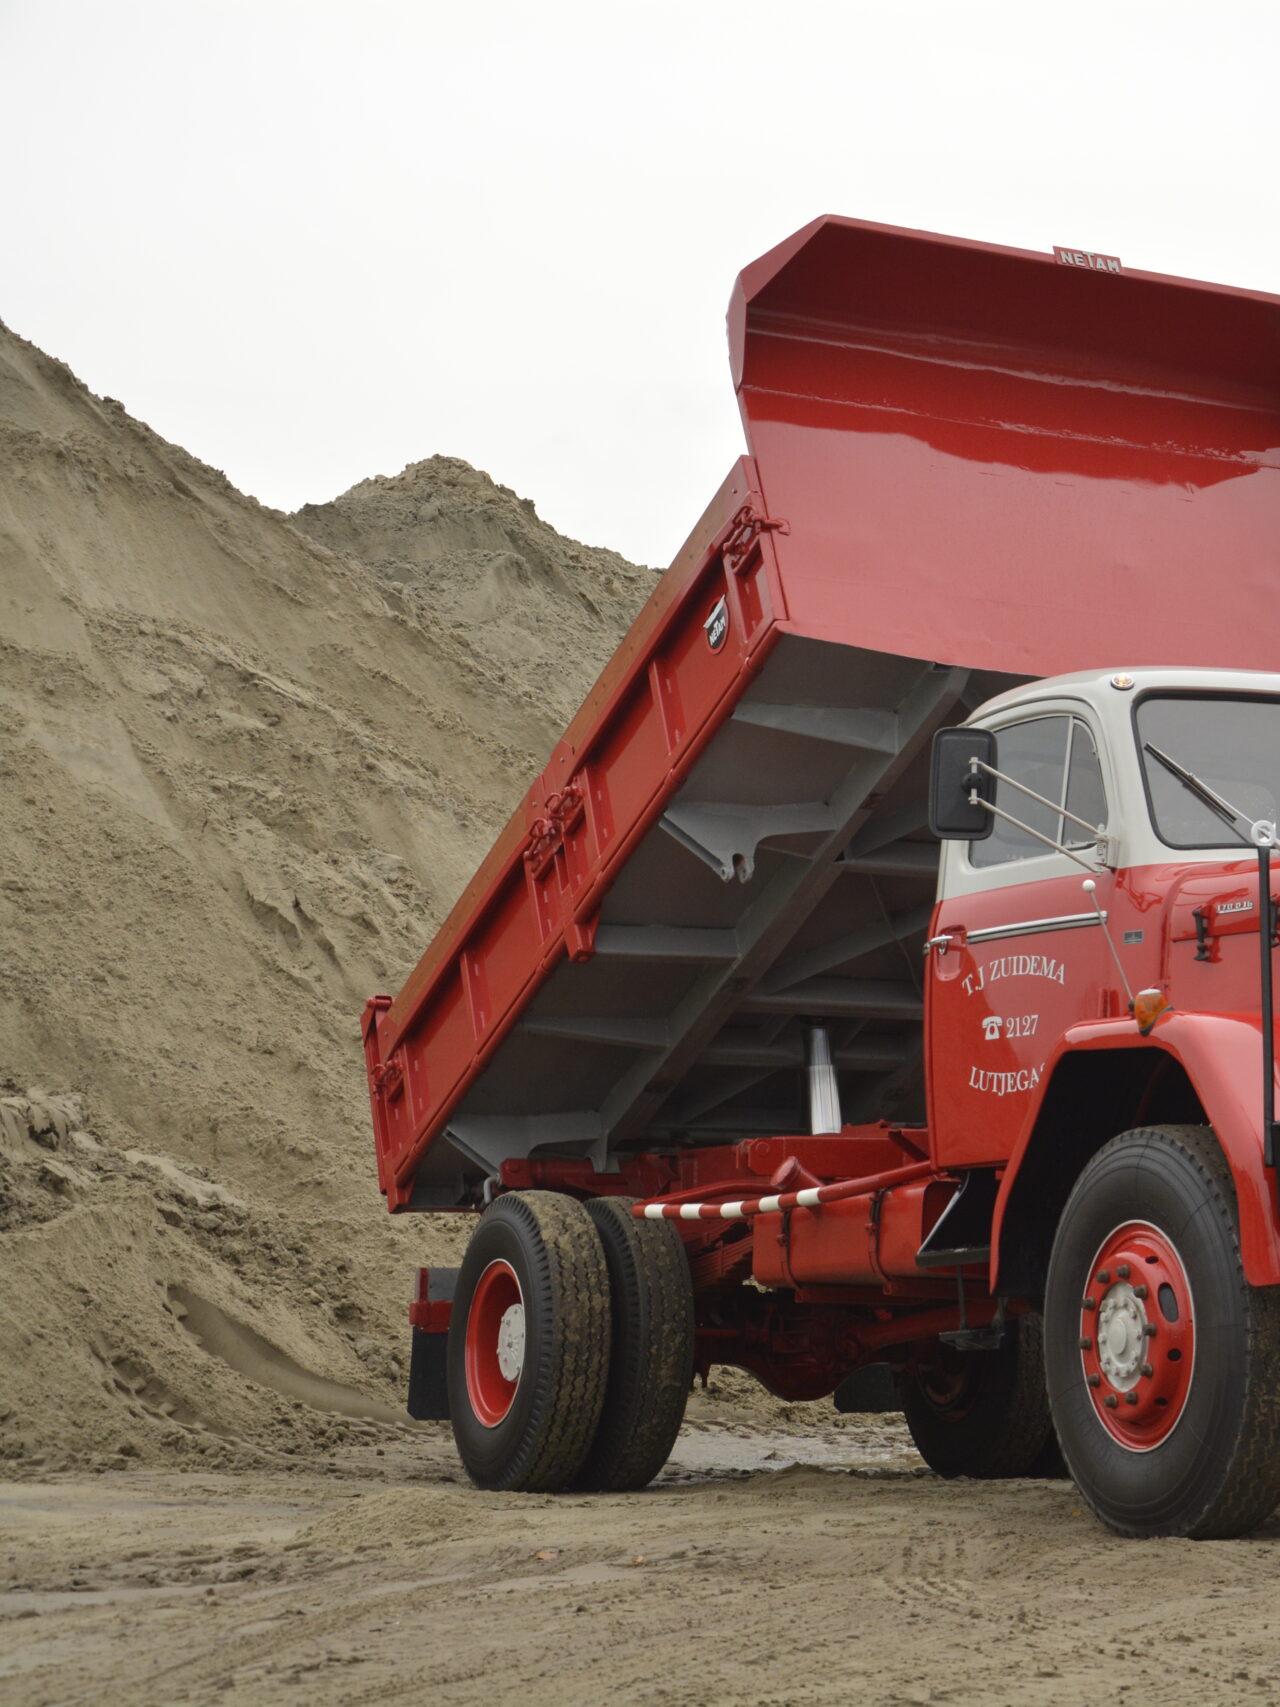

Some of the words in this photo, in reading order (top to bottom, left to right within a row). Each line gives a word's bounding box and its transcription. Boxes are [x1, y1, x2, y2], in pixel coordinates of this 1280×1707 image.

[1060, 251, 1120, 273] NETAM
[709, 615, 726, 646] NETAM
[989, 955, 1065, 985] ZUIDEMA
[1006, 1014, 1039, 1038] 2127
